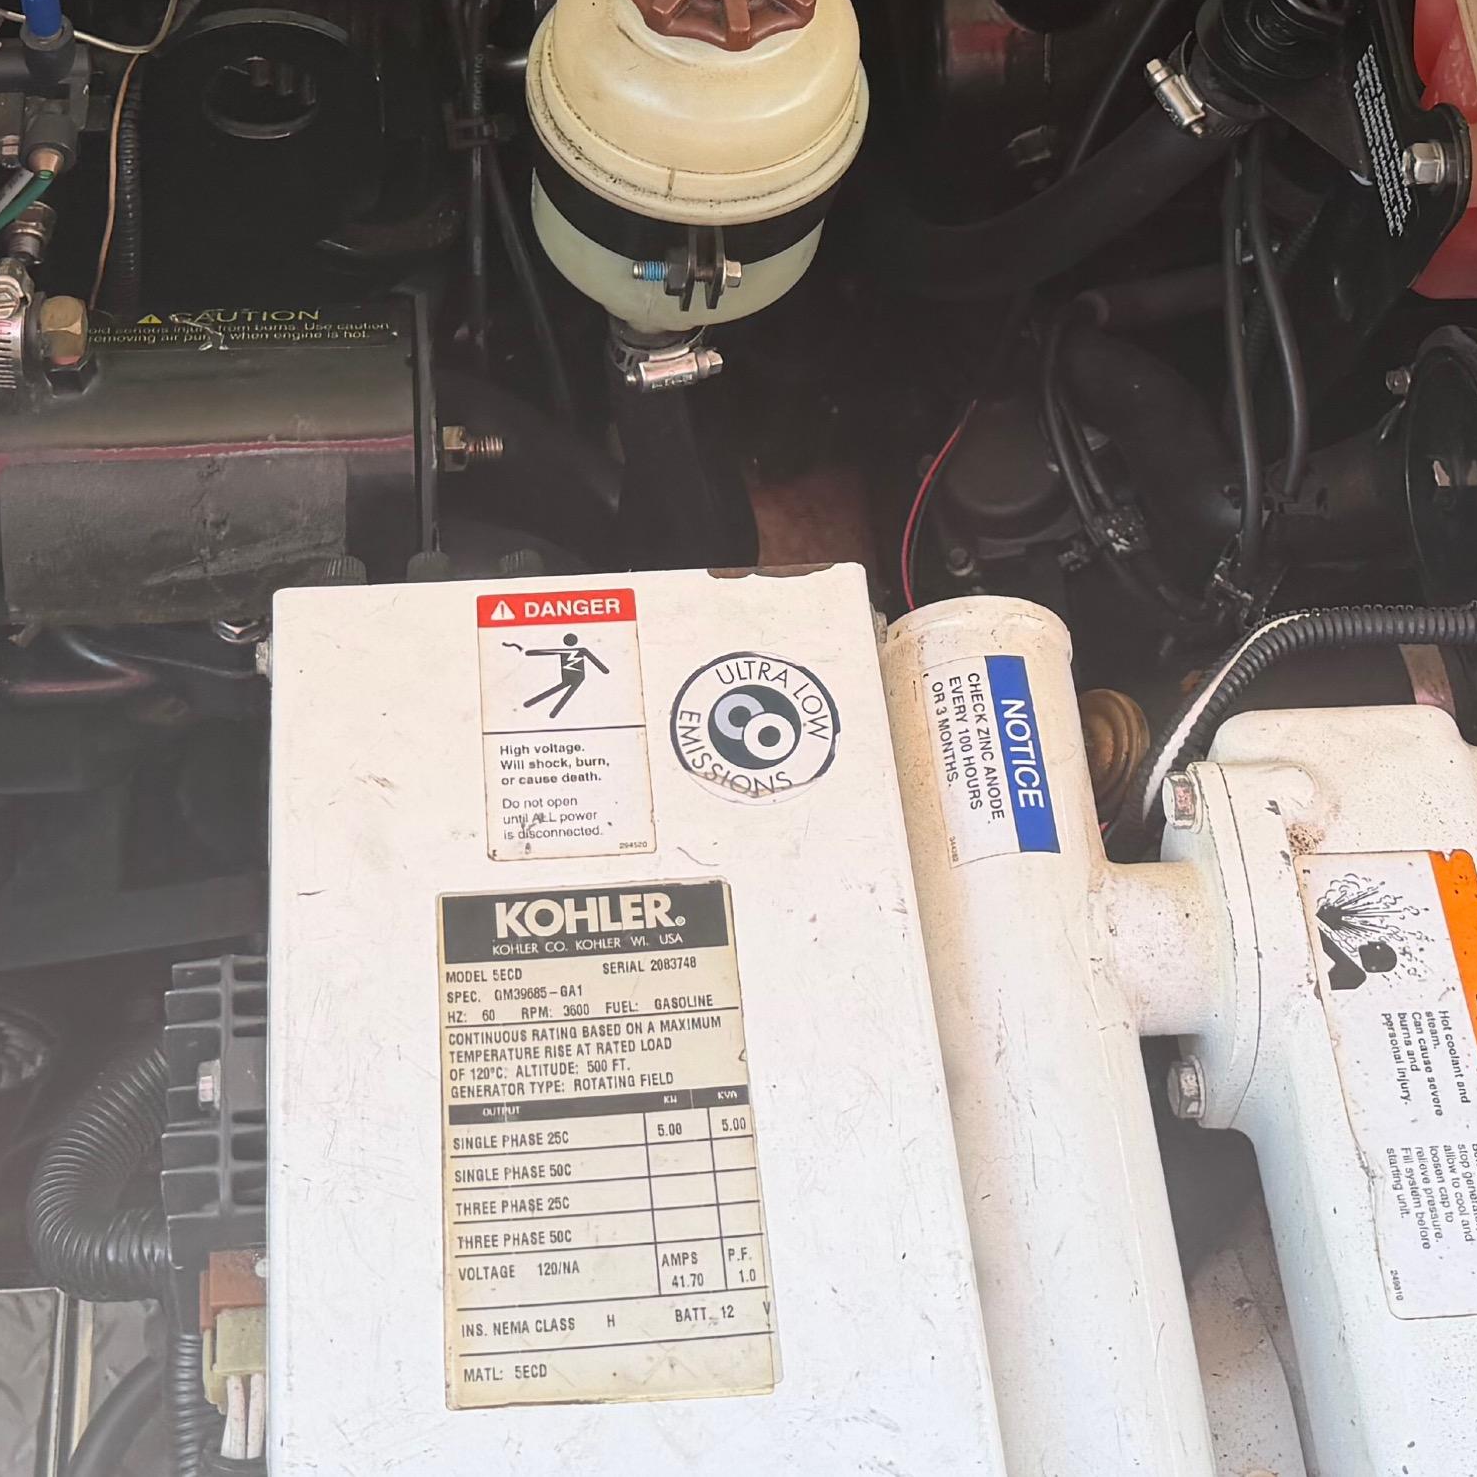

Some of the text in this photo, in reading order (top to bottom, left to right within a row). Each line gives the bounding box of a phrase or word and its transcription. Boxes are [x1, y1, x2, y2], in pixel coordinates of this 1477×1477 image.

[169, 309, 322, 323] CAUTION
[524, 599, 620, 618] DANGER
[932, 682, 945, 704] OR
[936, 707, 947, 715] 3
[678, 661, 829, 797] ULTRA LOW EMISSIONS
[500, 743, 585, 756] High voltage.
[949, 676, 983, 810] EVERY 100 HOURS
[968, 673, 1004, 820] CHECK ZINC ANODE
[501, 757, 610, 770] Will shock, burn,
[1001, 700, 1044, 808] NOTICE
[502, 772, 601, 785] or cause death.
[503, 797, 577, 810] Do not open
[503, 812, 597, 824] until ALL power
[504, 825, 603, 839] is disconnected.
[495, 892, 676, 938] KOHLER
[493, 933, 682, 956] KOHLER CO. KOHLER WI. USA
[446, 957, 696, 983] MODEL 5ECD SERIAL 2083748
[448, 994, 713, 1023] HZ: 60 RPM: 3600 FUEL: GASOLINE
[449, 1016, 722, 1046] CONTINUOUS RATING BASED ON A MAXIMUM
[450, 1038, 672, 1064] TEMPERATURE RISE AT RATED LOAD
[1439, 1010, 1470, 1103] Hot coolant and
[451, 1072, 674, 1099] GENERATOR TYPE: ROTATING FIELD
[453, 1118, 746, 1150] SINGLE PHASE 25C 5.00 5.00
[454, 1164, 571, 1183] SINGLE PHASE 50C
[456, 1197, 570, 1216] THREE PHASE 25C
[458, 1230, 572, 1249] THREE PHASE 50C
[662, 1252, 698, 1267] AMPS
[458, 1261, 580, 1281] VOLTAGE 120/NA
[672, 1273, 704, 1288] 41.70
[739, 1269, 756, 1283] 1.0
[463, 1364, 547, 1382] MATL: 5ECD
